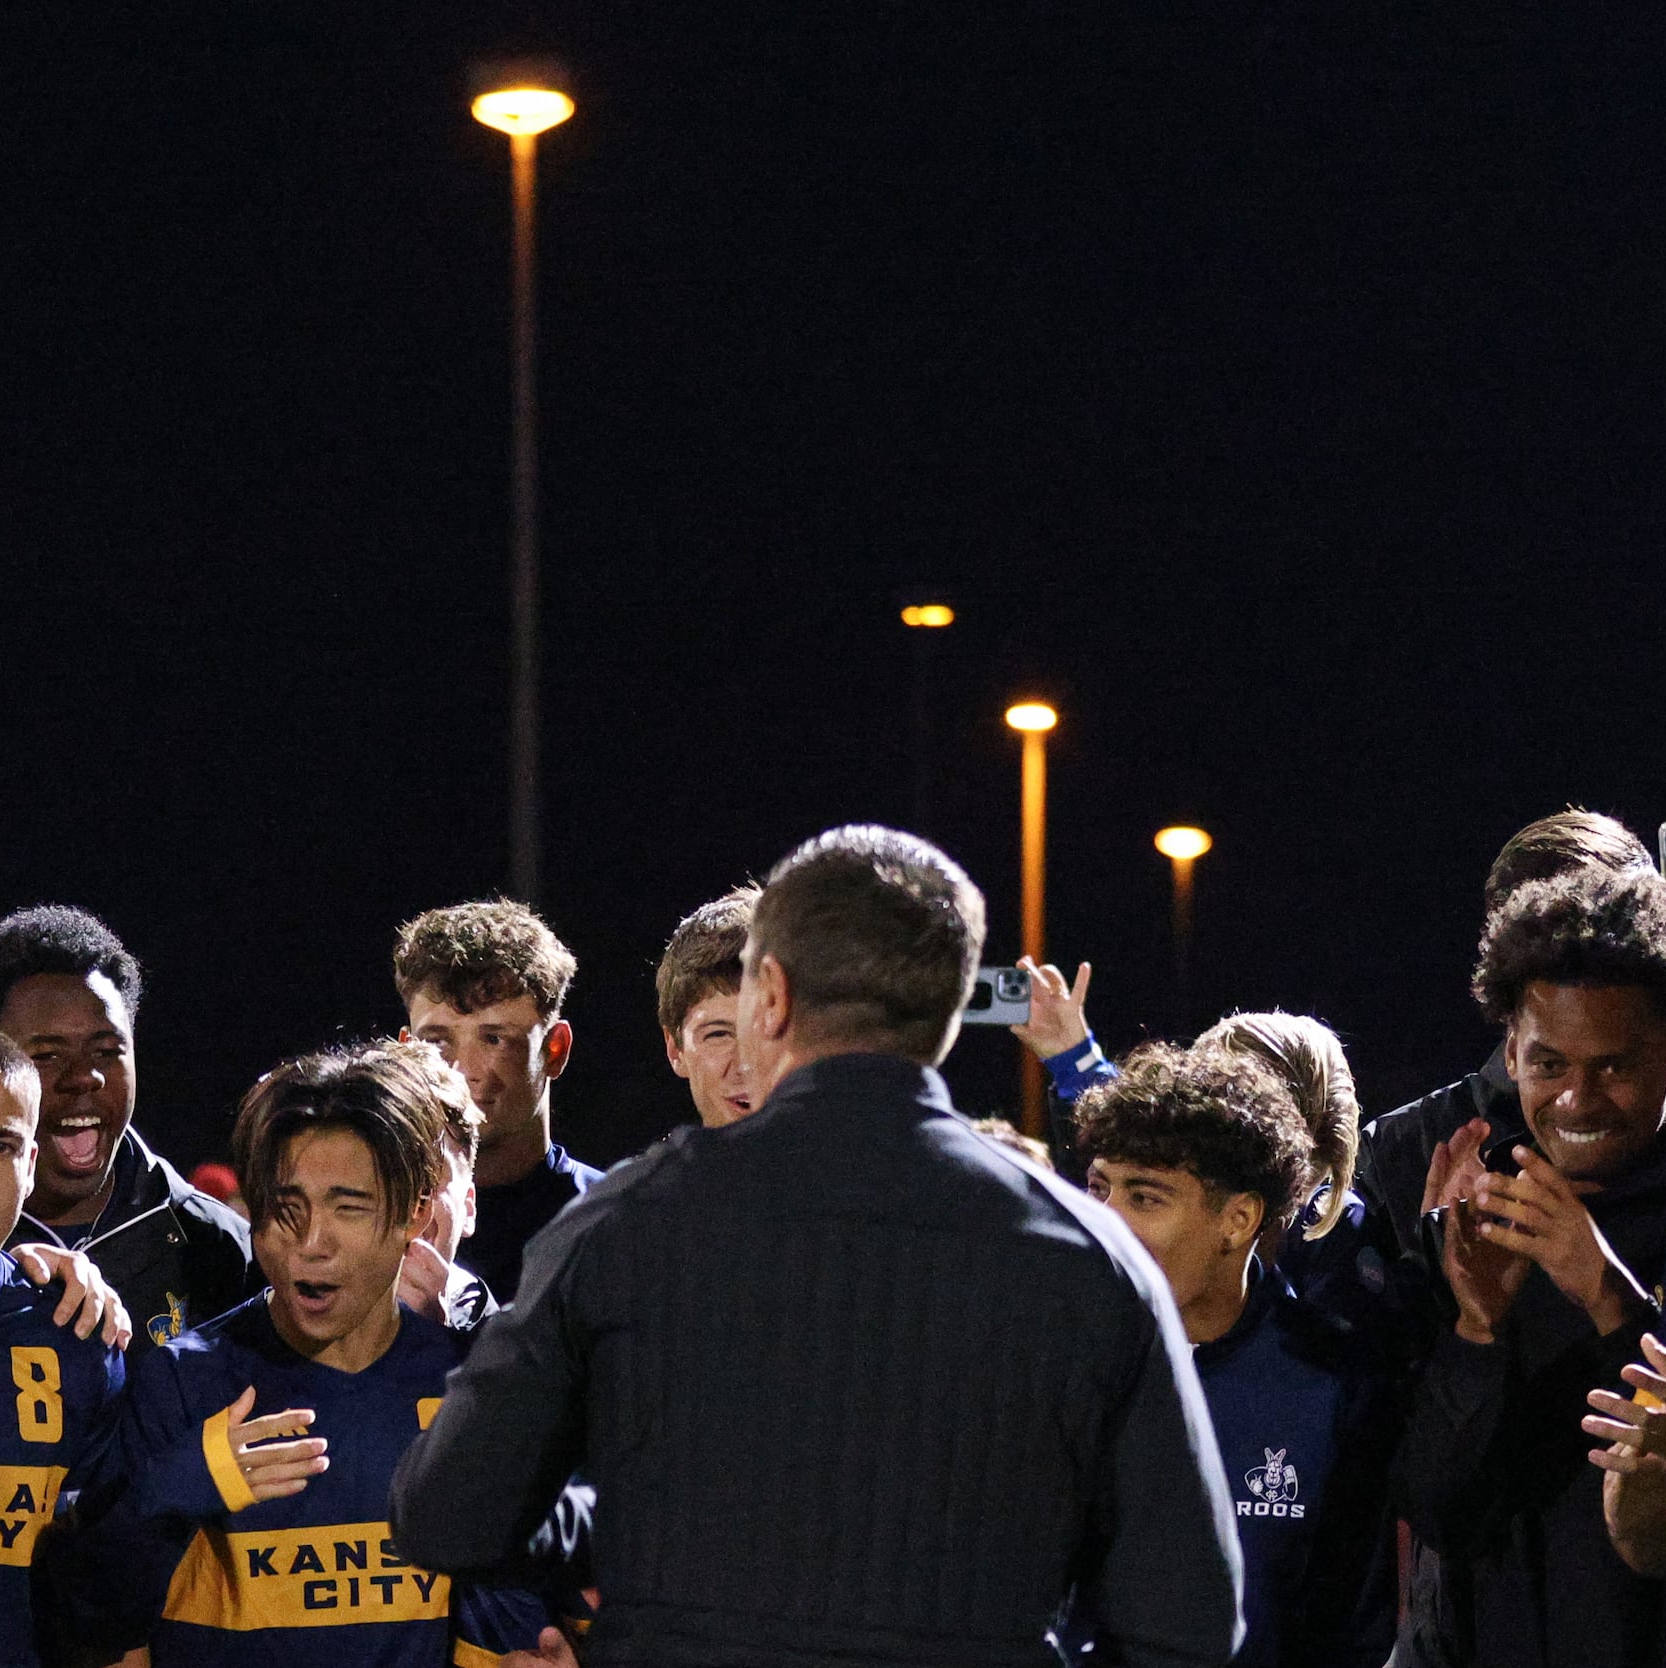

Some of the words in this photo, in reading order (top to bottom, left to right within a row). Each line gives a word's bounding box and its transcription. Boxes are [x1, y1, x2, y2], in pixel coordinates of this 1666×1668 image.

[9, 1346, 64, 1443] 8
[1235, 1501, 1306, 1519] ROOS
[304, 1574, 438, 1610] CITY
